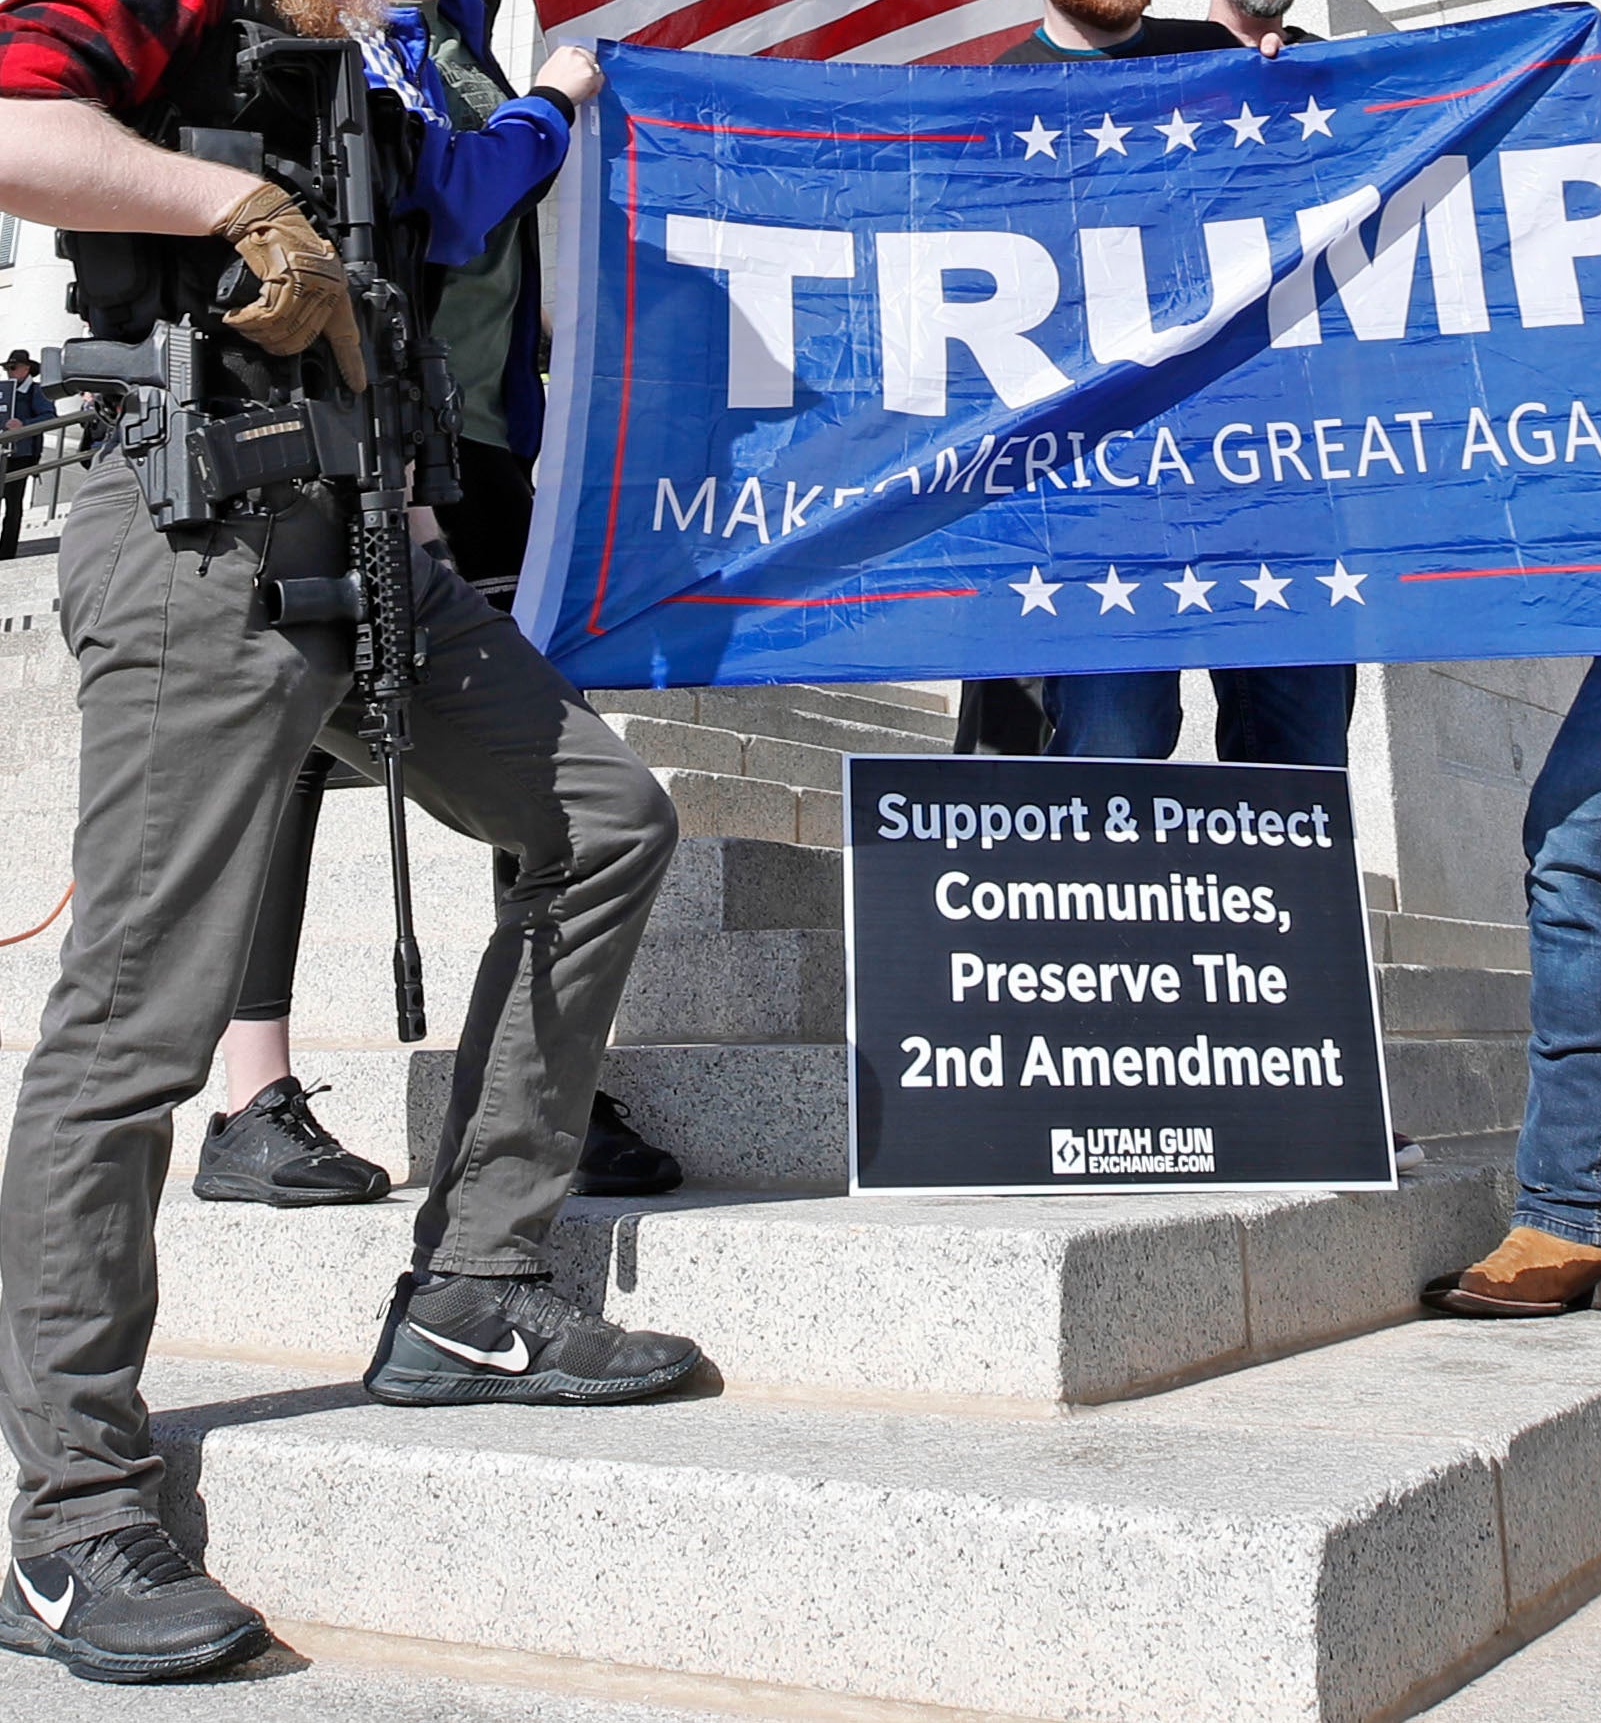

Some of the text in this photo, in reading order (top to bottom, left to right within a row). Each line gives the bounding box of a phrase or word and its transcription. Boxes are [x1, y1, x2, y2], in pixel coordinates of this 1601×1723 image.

[1211, 411, 1433, 485] GREAT
[877, 792, 1333, 850] Support & Protect
[934, 870, 1293, 933] Communities,
[950, 952, 1289, 1004] Preserve The
[899, 1034, 1345, 1088] 2nd Amendment
[1086, 1127, 1214, 1155] UTAH GUN
[1088, 1155, 1215, 1174] EXCHANGE.COM
